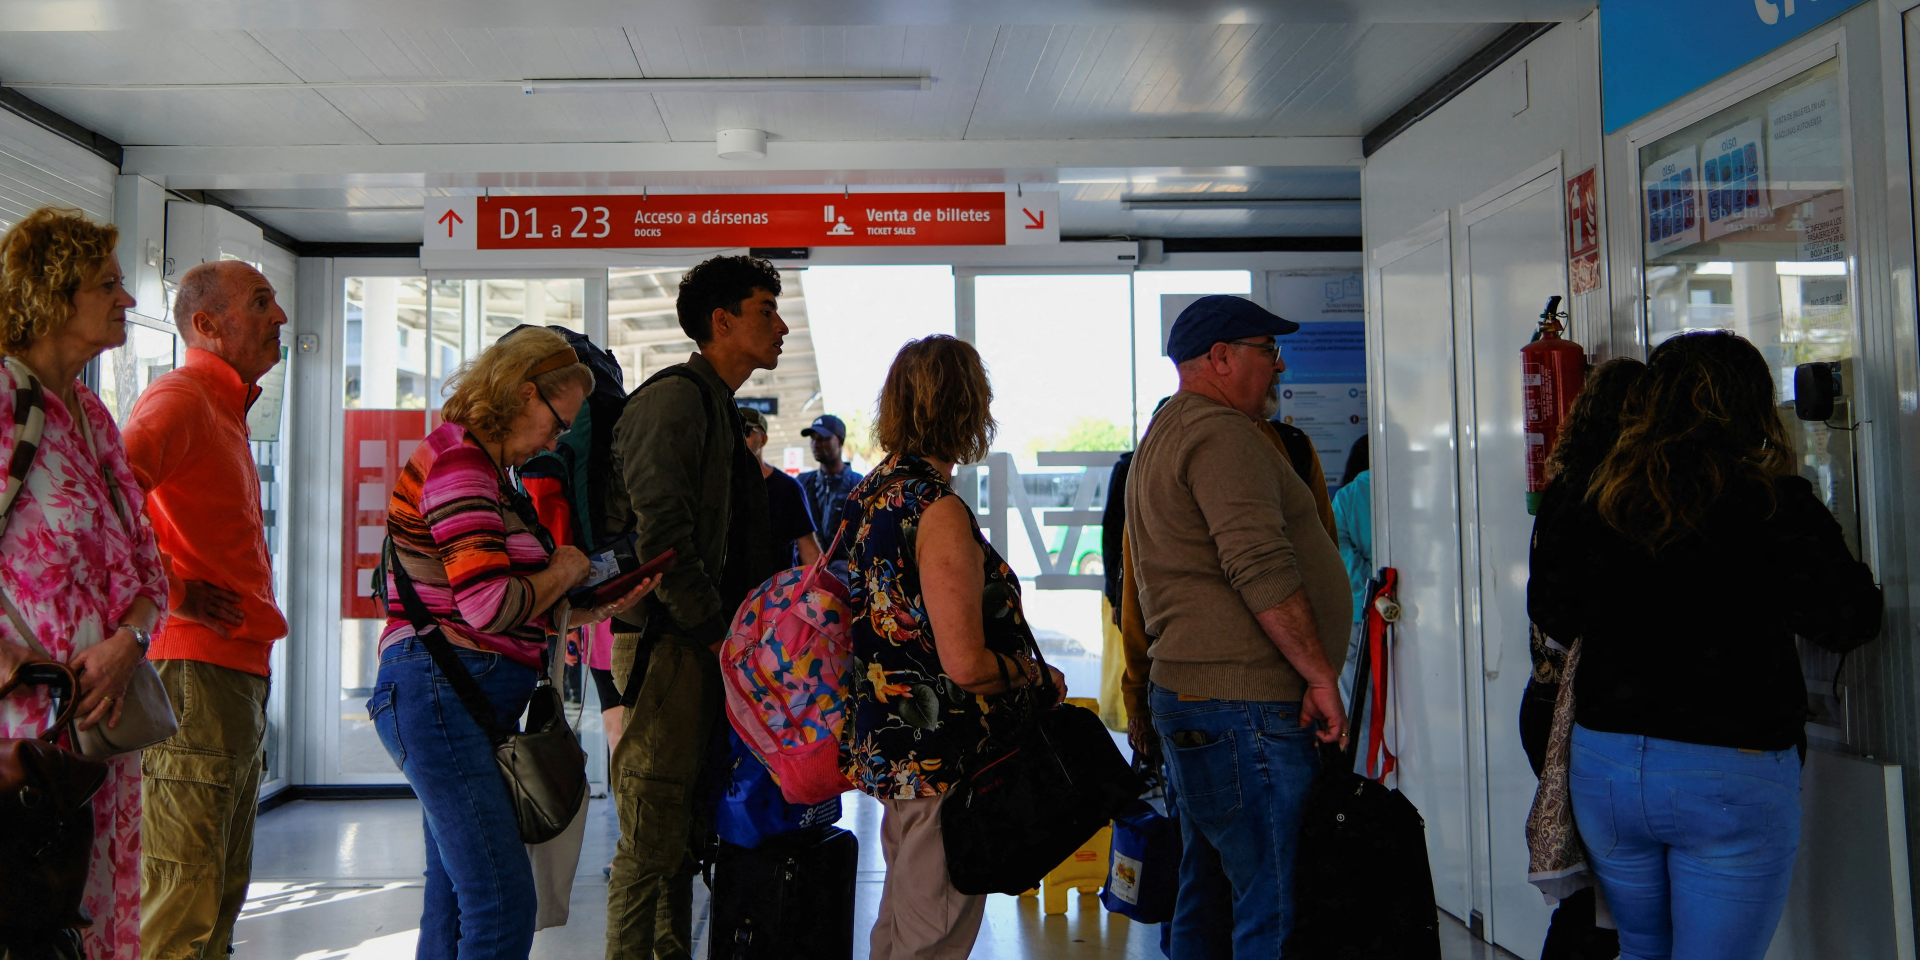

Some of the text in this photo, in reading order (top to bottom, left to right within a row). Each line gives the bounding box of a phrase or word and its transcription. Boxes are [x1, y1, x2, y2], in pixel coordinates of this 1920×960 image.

[1787, 112, 1793, 121] DE
[1793, 105, 1810, 118] BILLETES
[1721, 137, 1738, 151] alsa
[1662, 163, 1676, 177] alsa
[634, 209, 769, 225] Acceso a dársenas
[866, 208, 990, 222] Venta de billetes
[1833, 216, 1842, 226] LOS
[500, 206, 610, 239] D1 a 23
[634, 228, 661, 237] DOCKS
[866, 227, 916, 235] TICKET SALES
